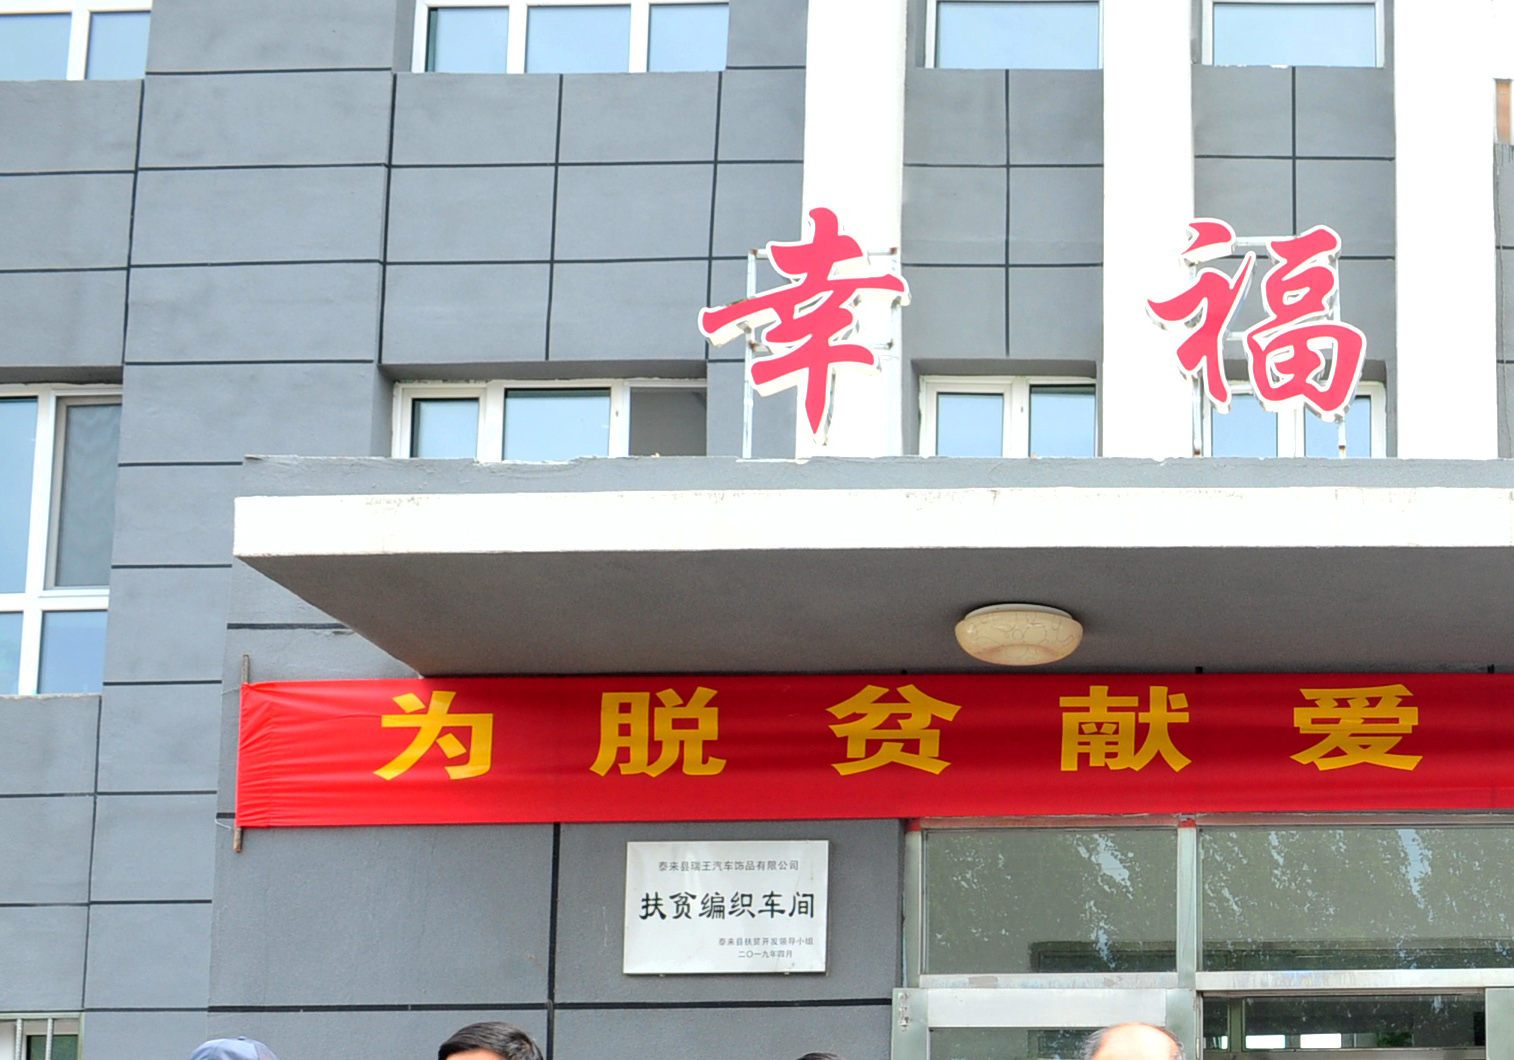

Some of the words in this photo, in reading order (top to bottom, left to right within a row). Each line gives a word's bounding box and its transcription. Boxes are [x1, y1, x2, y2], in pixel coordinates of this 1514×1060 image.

[373, 684, 1424, 780] 为脱贫献爱
[638, 890, 815, 920] 扶贫编织车间
[718, 937, 814, 946] 泰来县扶贫开发领导小组
